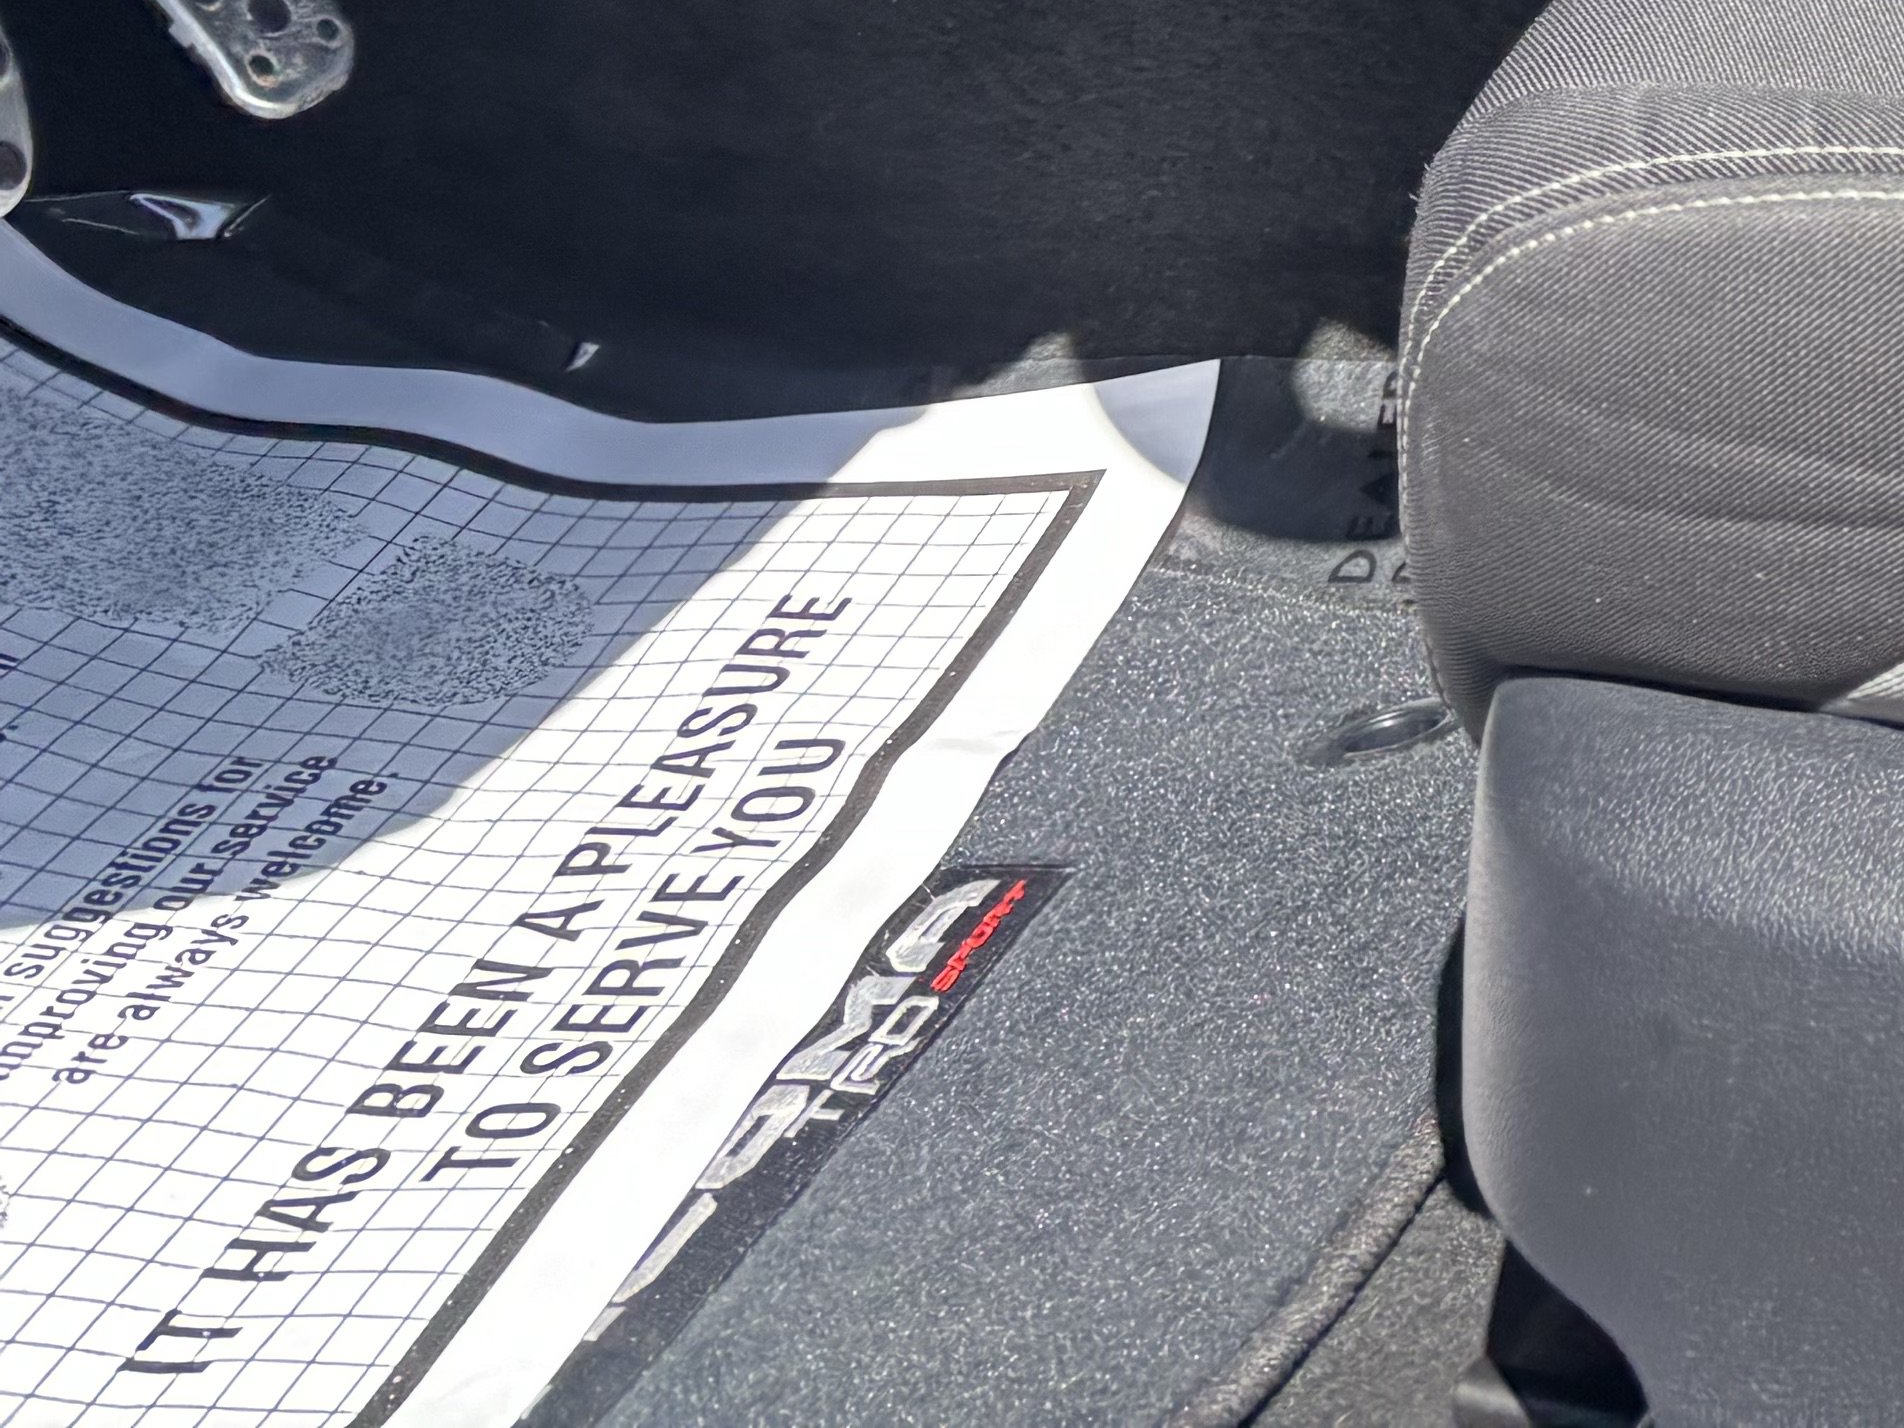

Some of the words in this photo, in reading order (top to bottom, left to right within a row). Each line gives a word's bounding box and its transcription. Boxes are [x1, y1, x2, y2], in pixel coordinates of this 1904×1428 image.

[551, 593, 854, 879] PLEASURE
[0, 921, 174, 1082] mproving
[152, 861, 225, 912] our
[210, 755, 338, 857] service
[3, 801, 217, 980] suggestions
[194, 755, 263, 796] for
[510, 898, 607, 942] A
[51, 1032, 130, 1085] are
[117, 912, 250, 1022] always
[345, 956, 556, 1119] BEEN
[418, 1101, 562, 1184] TO
[519, 871, 747, 1076] SERVE
[689, 736, 848, 855] YOU
[782, 995, 940, 1139] TRD
[199, 1145, 392, 1283] HAS
[116, 1307, 244, 1375] IT
